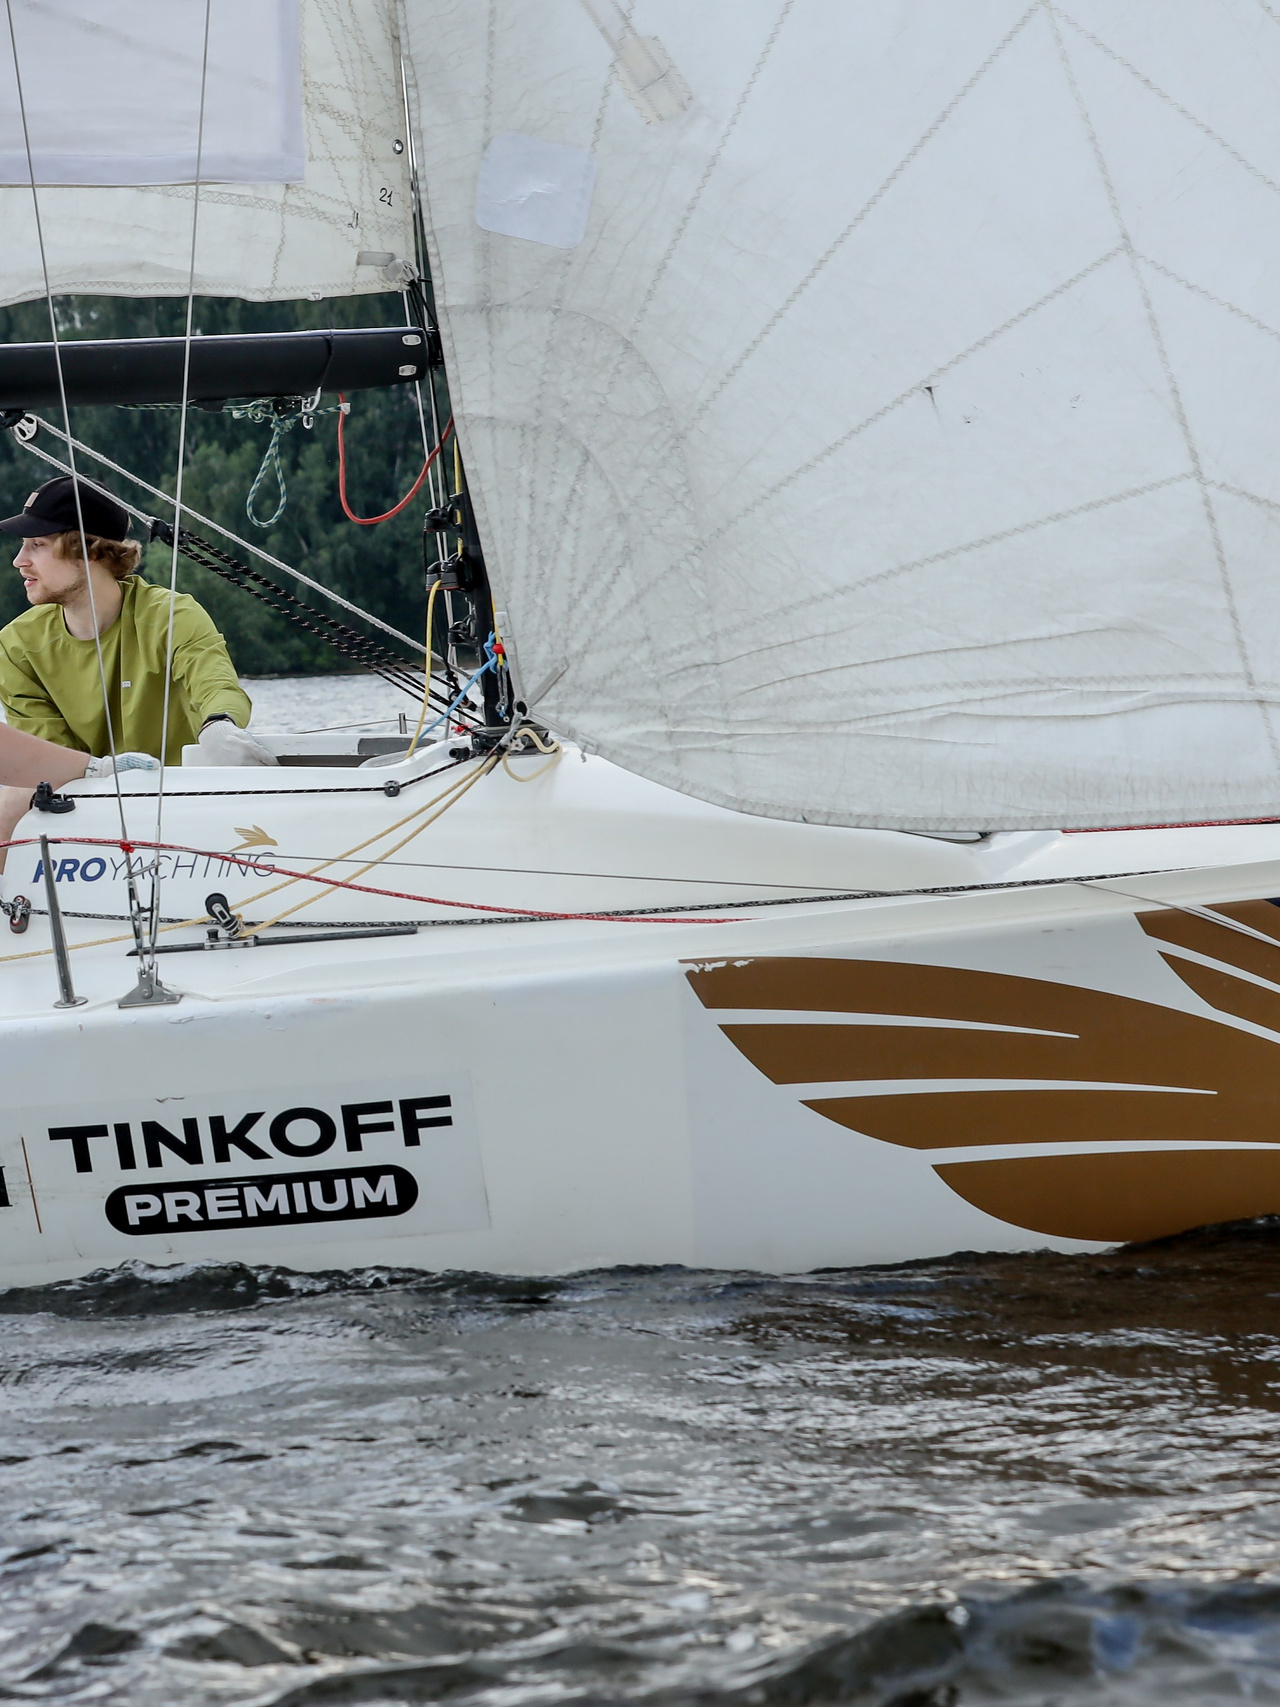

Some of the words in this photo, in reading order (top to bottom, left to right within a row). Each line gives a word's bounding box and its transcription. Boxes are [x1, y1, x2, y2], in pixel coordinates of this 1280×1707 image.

[378, 187, 394, 208] 21
[48, 1095, 454, 1173] TINKOFF
[123, 1174, 399, 1226] PREMIUM
